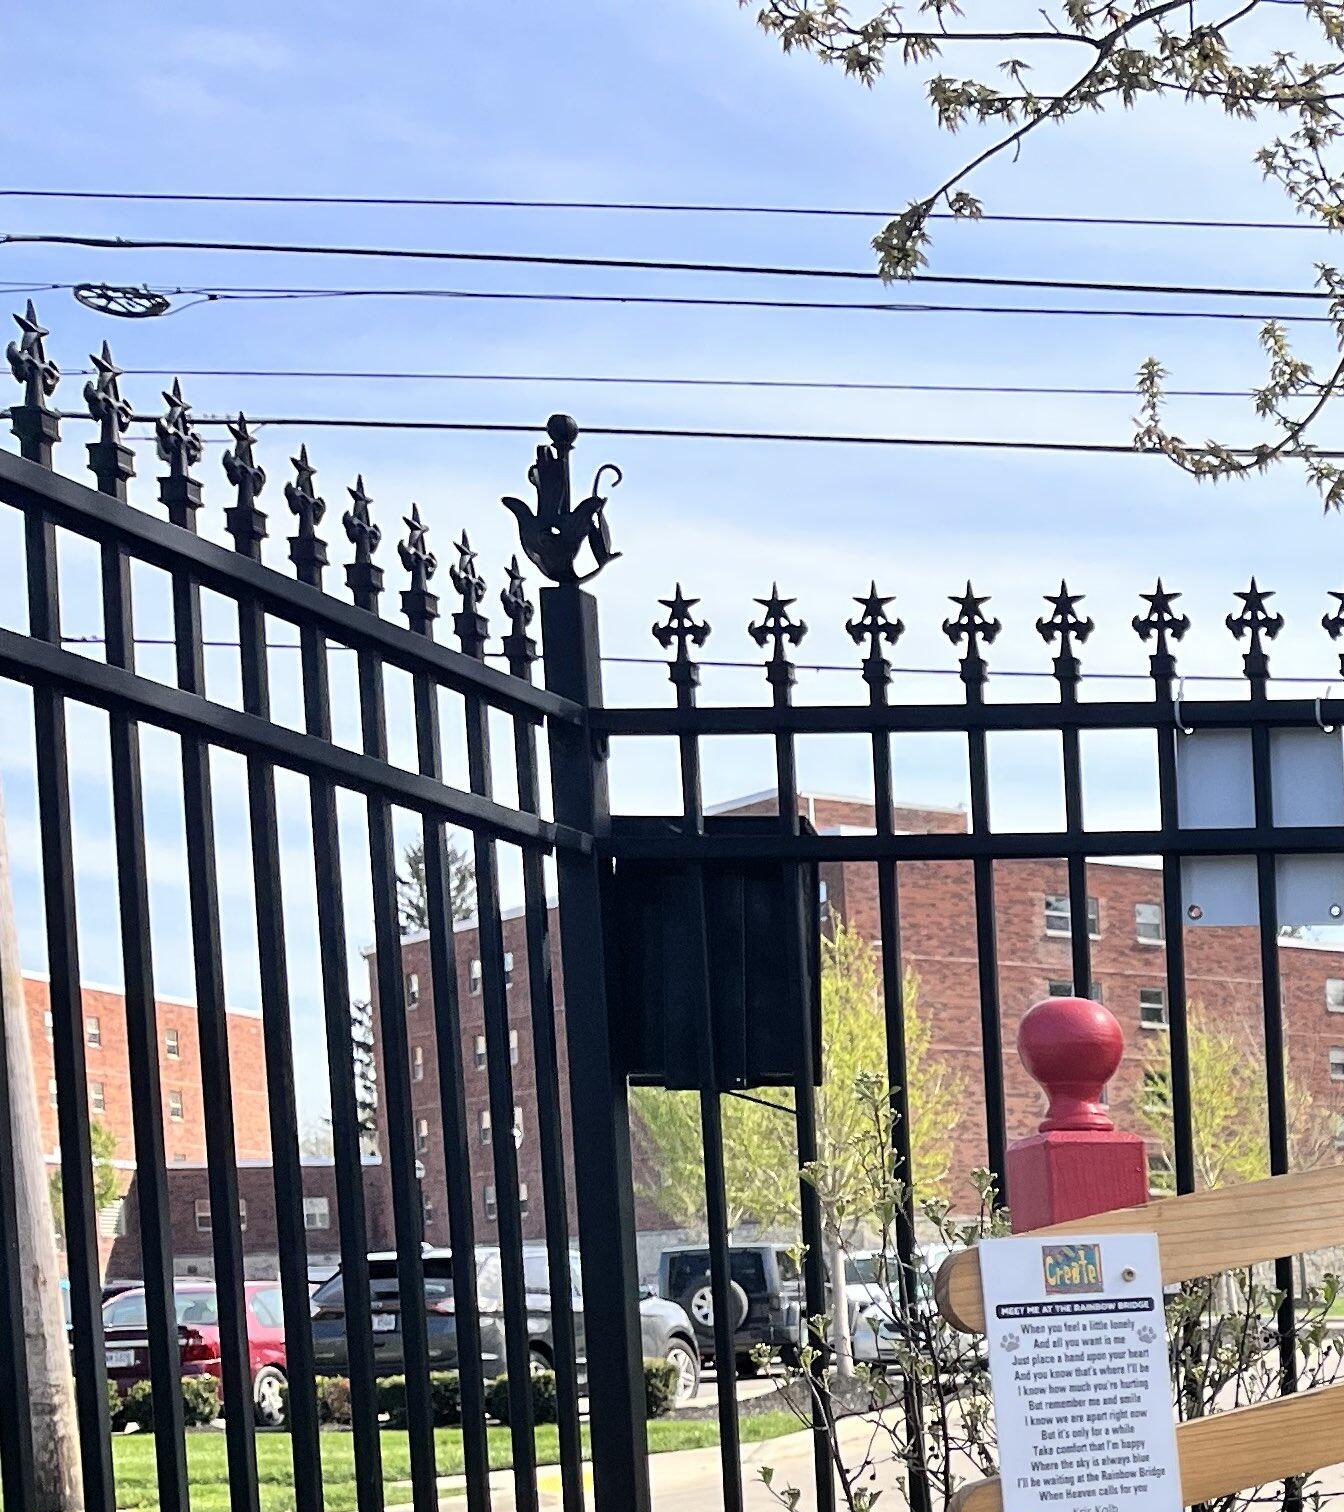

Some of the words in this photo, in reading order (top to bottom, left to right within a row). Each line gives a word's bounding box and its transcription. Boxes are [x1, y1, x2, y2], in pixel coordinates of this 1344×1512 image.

[1001, 1304, 1024, 1316] MEET
[1027, 1305, 1040, 1314] ME
[1042, 1304, 1053, 1314] AT
[1056, 1304, 1072, 1313] THE
[1074, 1302, 1117, 1312] RAINBOW
[1118, 1300, 1150, 1310] BRIDGE
[1021, 1323, 1046, 1334] When
[1048, 1325, 1062, 1335] you
[1064, 1321, 1080, 1331] feel
[1089, 1320, 1108, 1330] little
[1110, 1318, 1135, 1331] lonely
[1034, 1339, 1050, 1348] And
[1052, 1338, 1063, 1348] all
[1065, 1339, 1079, 1350] you
[1082, 1336, 1102, 1346] want
[1105, 1337, 1112, 1345] is
[1113, 1336, 1125, 1344] me
[1012, 1355, 1029, 1366] Just
[1032, 1354, 1055, 1367] place
[1064, 1351, 1084, 1361] hand
[1087, 1353, 1106, 1364] upon
[1108, 1351, 1126, 1362] your
[1128, 1349, 1149, 1358] heart
[1015, 1371, 1030, 1380] And
[1034, 1371, 1048, 1382] you
[1050, 1368, 1073, 1379] know
[1074, 1366, 1097, 1377] that's
[1099, 1364, 1125, 1375] where
[1127, 1363, 1138, 1373] I'll
[1139, 1363, 1149, 1373] be
[1018, 1386, 1022, 1396] I
[1023, 1385, 1046, 1395] know
[1048, 1383, 1066, 1394] how
[1069, 1381, 1091, 1392] much
[1093, 1380, 1118, 1393] you're
[1120, 1378, 1149, 1390] hurting
[1028, 1400, 1043, 1411] But
[1045, 1398, 1086, 1409] remember
[1102, 1394, 1117, 1405] and
[1119, 1392, 1141, 1404] smile
[1025, 1416, 1029, 1426] I
[1030, 1415, 1054, 1425] know
[1055, 1415, 1068, 1424] we
[1070, 1414, 1084, 1423] are
[1086, 1411, 1108, 1424] apart
[1109, 1409, 1128, 1422] right
[1130, 1410, 1148, 1418] now
[1041, 1429, 1056, 1440] But
[1057, 1428, 1070, 1439] it's
[1072, 1427, 1089, 1439] only
[1091, 1426, 1102, 1436] for
[1105, 1427, 1110, 1435] a
[1112, 1423, 1135, 1434] while
[1033, 1445, 1054, 1456] Take
[1056, 1442, 1087, 1455] comfort
[1089, 1440, 1105, 1451] that
[1106, 1439, 1119, 1450] I'm
[1121, 1438, 1145, 1451] happy
[1031, 1461, 1059, 1472] Where
[1061, 1459, 1074, 1469] the
[1076, 1457, 1090, 1469] sky
[1092, 1456, 1099, 1467] is
[1101, 1454, 1131, 1466] always
[1132, 1452, 1150, 1463] blue
[1017, 1477, 1028, 1489] I'll
[1031, 1476, 1041, 1487] be
[1043, 1474, 1075, 1487] waiting
[1077, 1474, 1085, 1483] at
[1087, 1471, 1099, 1482] the
[1101, 1468, 1137, 1481] Rainbow
[1139, 1466, 1166, 1479] Bridge
[1039, 1490, 1064, 1501] When
[1065, 1487, 1097, 1499] Heaven
[1098, 1485, 1118, 1496] calls
[1120, 1484, 1131, 1494] for
[1133, 1484, 1148, 1495] you
